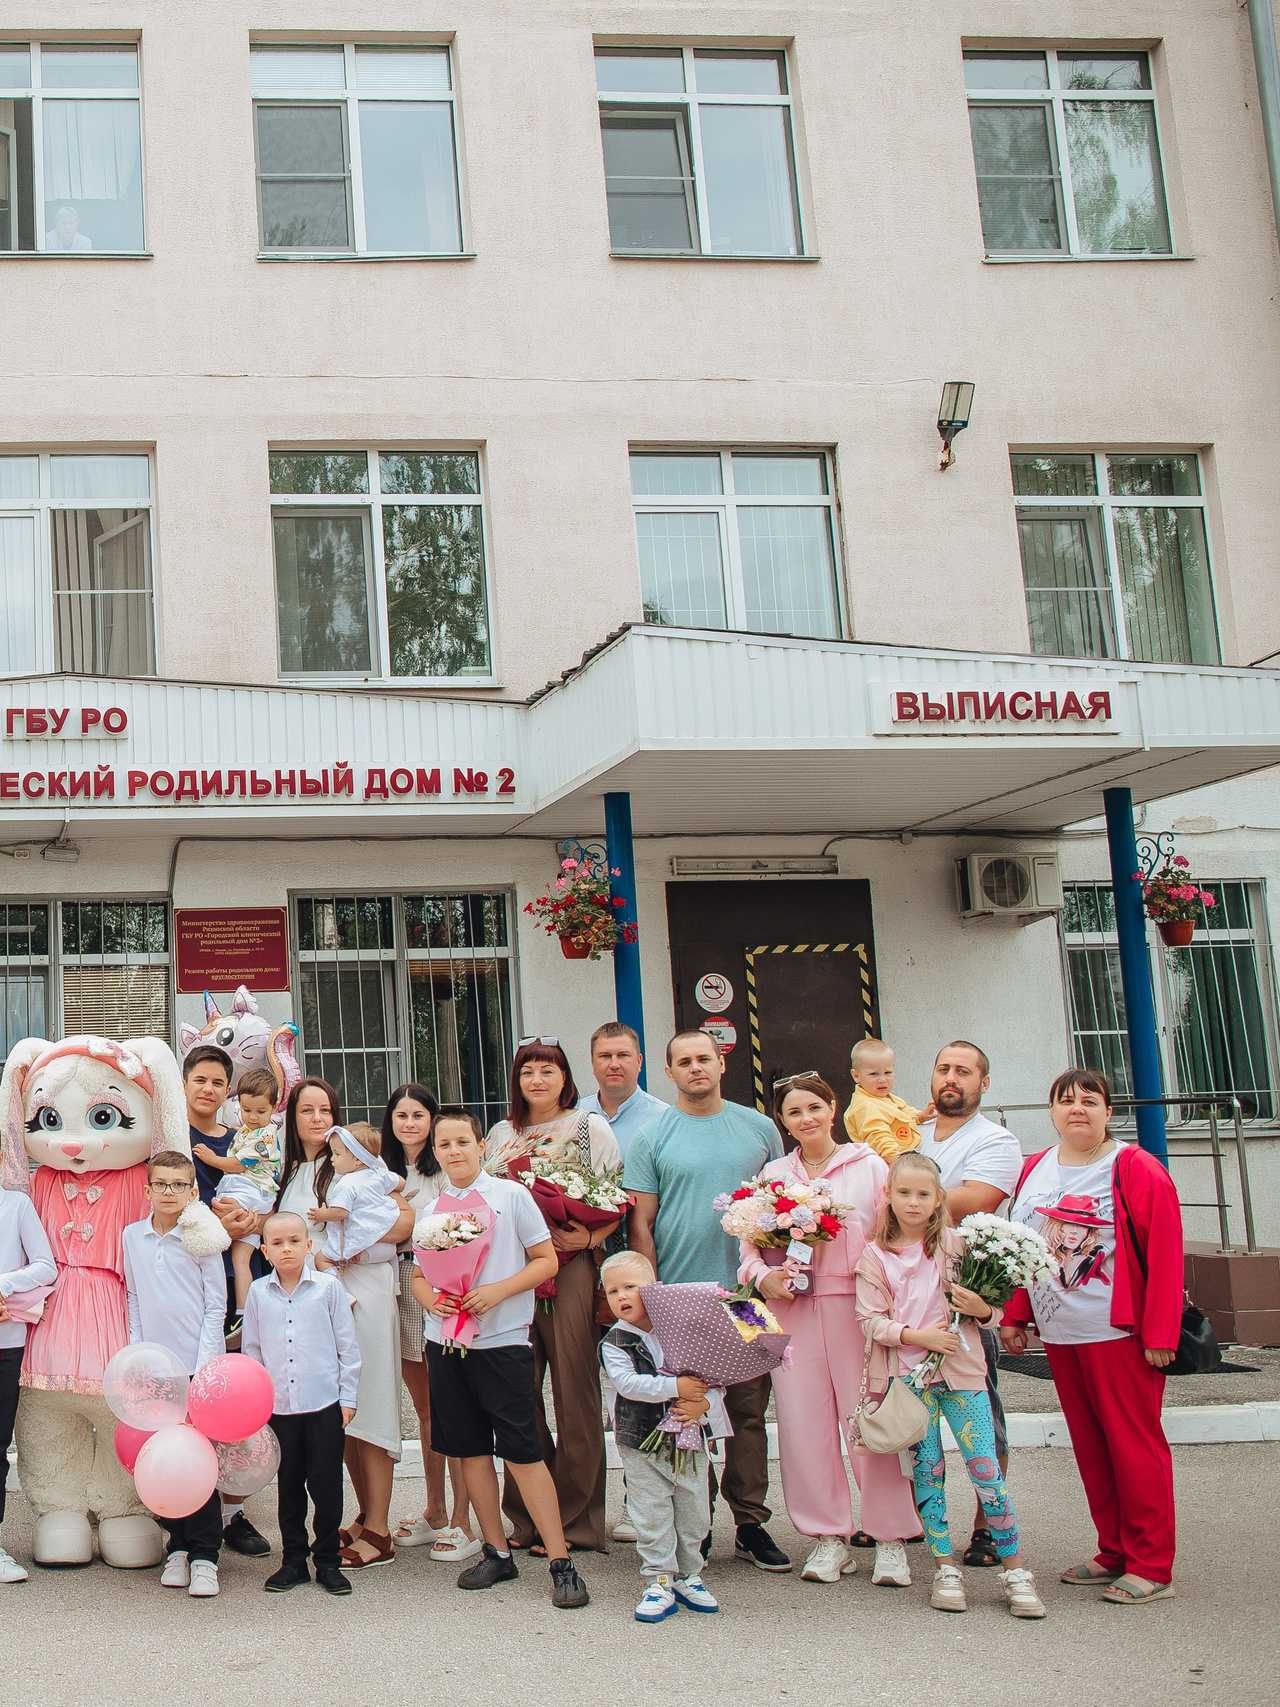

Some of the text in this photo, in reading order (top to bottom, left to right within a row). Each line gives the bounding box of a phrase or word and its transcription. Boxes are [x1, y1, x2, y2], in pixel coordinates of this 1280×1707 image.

[895, 691, 1112, 721] ВЫПИСНАЯ
[6, 707, 128, 736] ГБУ РО
[127, 761, 354, 803] РОДИЛЬНЫЙ
[363, 768, 442, 801] ДОМ
[452, 767, 489, 794] №
[496, 768, 517, 794] 2
